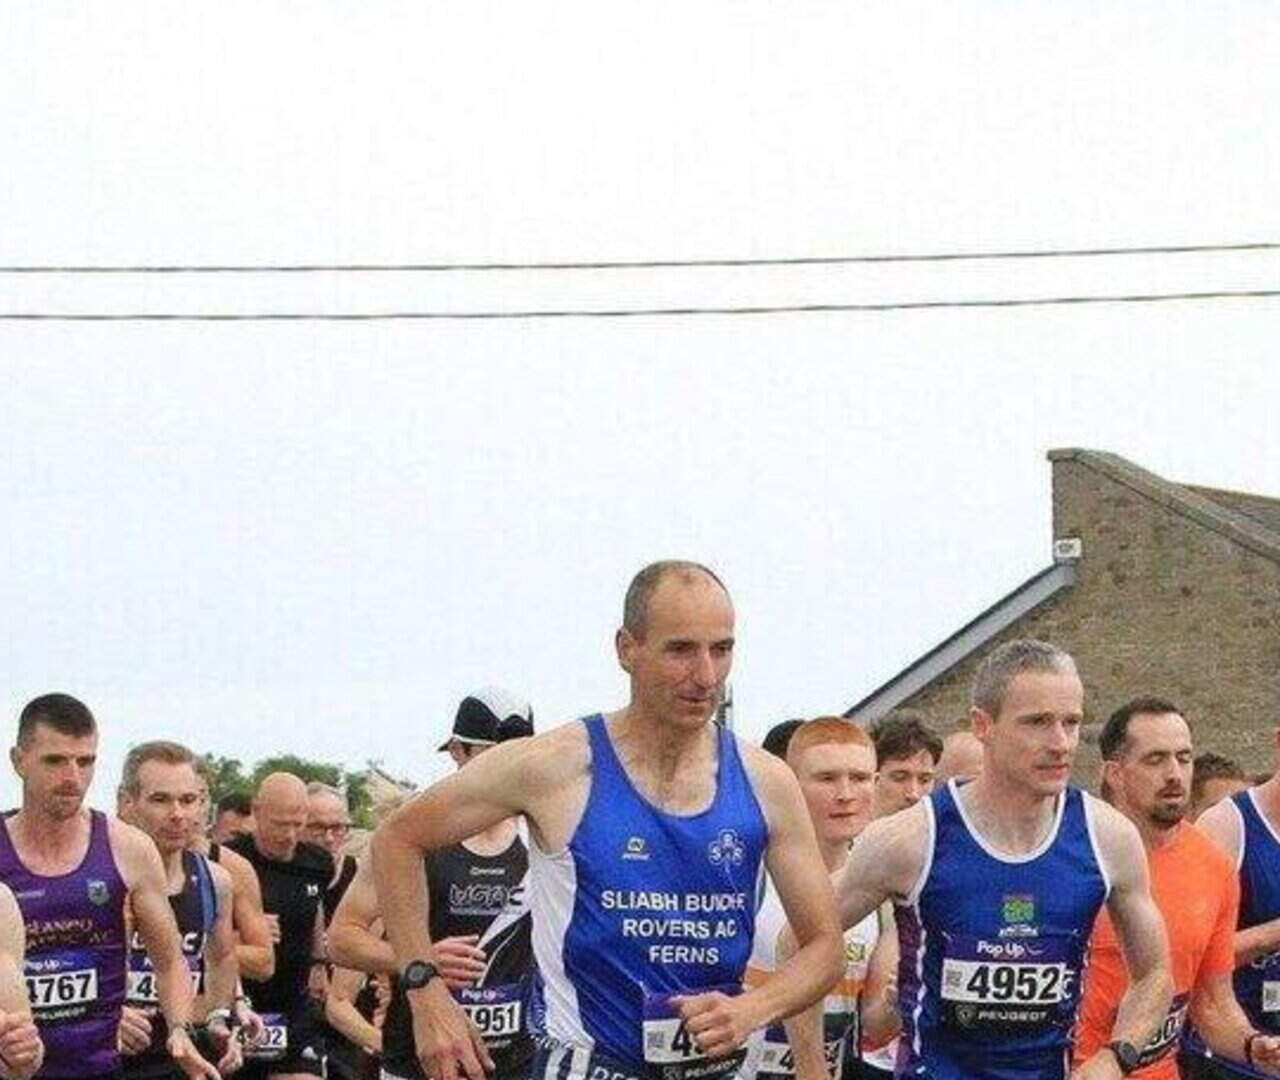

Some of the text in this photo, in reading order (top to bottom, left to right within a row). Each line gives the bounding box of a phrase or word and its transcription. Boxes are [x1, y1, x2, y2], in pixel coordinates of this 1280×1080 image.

[601, 890, 679, 911] SLIABH
[622, 918, 737, 939] ROVERS AC
[649, 945, 720, 965] FERNS
[977, 940, 1025, 958] Pop Up
[966, 964, 1060, 1001] 4952
[978, 1008, 1048, 1022] PEUGEOT
